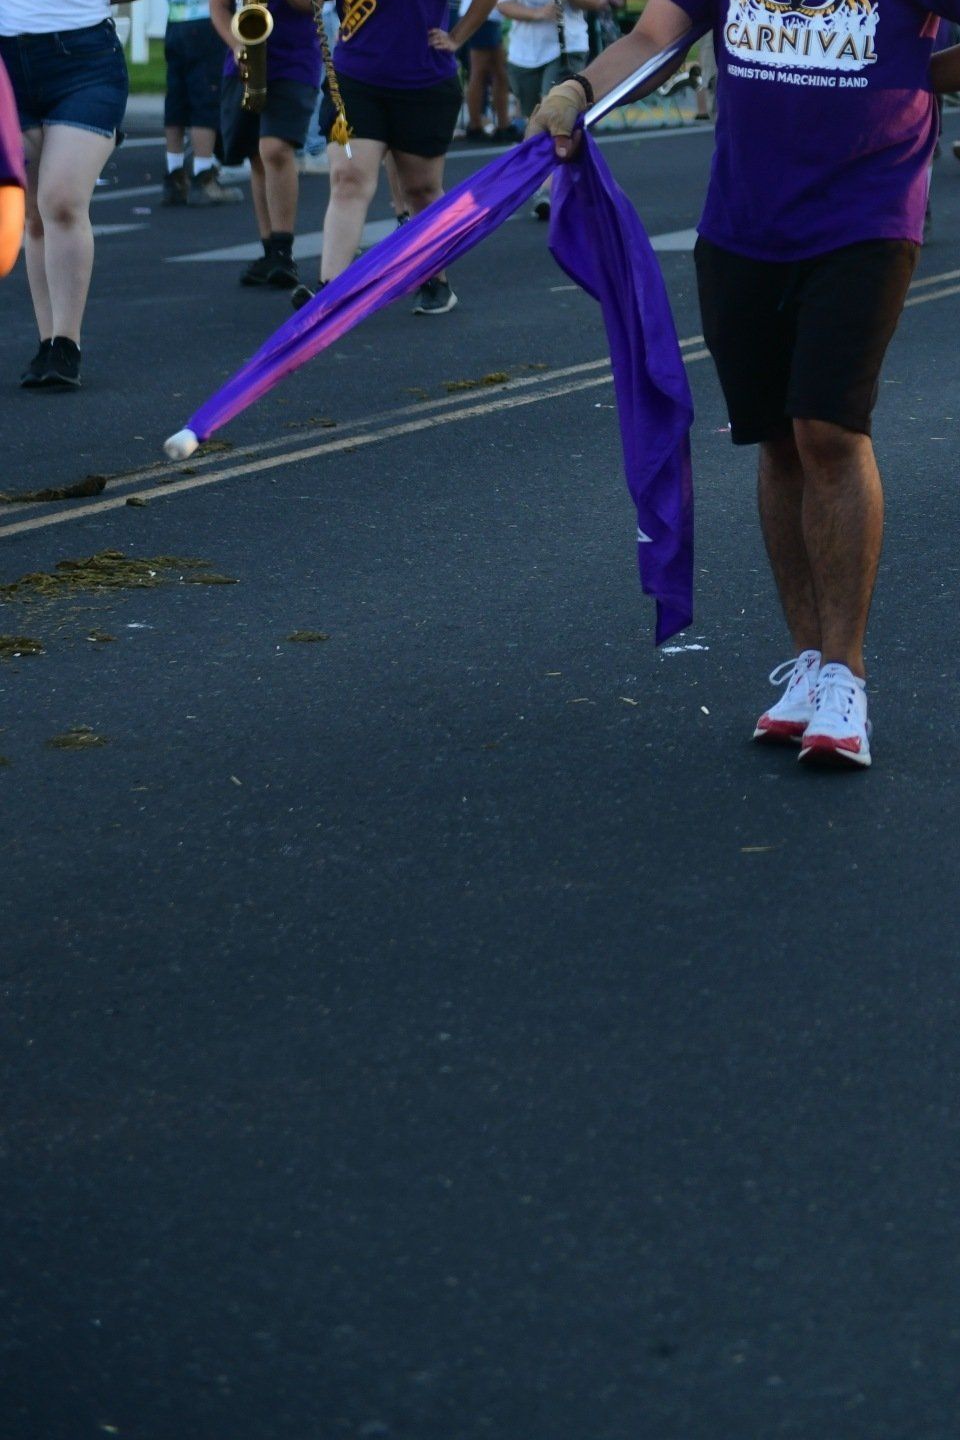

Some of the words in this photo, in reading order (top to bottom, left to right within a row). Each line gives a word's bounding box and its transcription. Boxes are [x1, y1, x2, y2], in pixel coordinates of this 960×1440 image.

[725, 22, 878, 61] CARNIVAL
[777, 71, 837, 87] MARCHING
[838, 76, 869, 88] BAND
